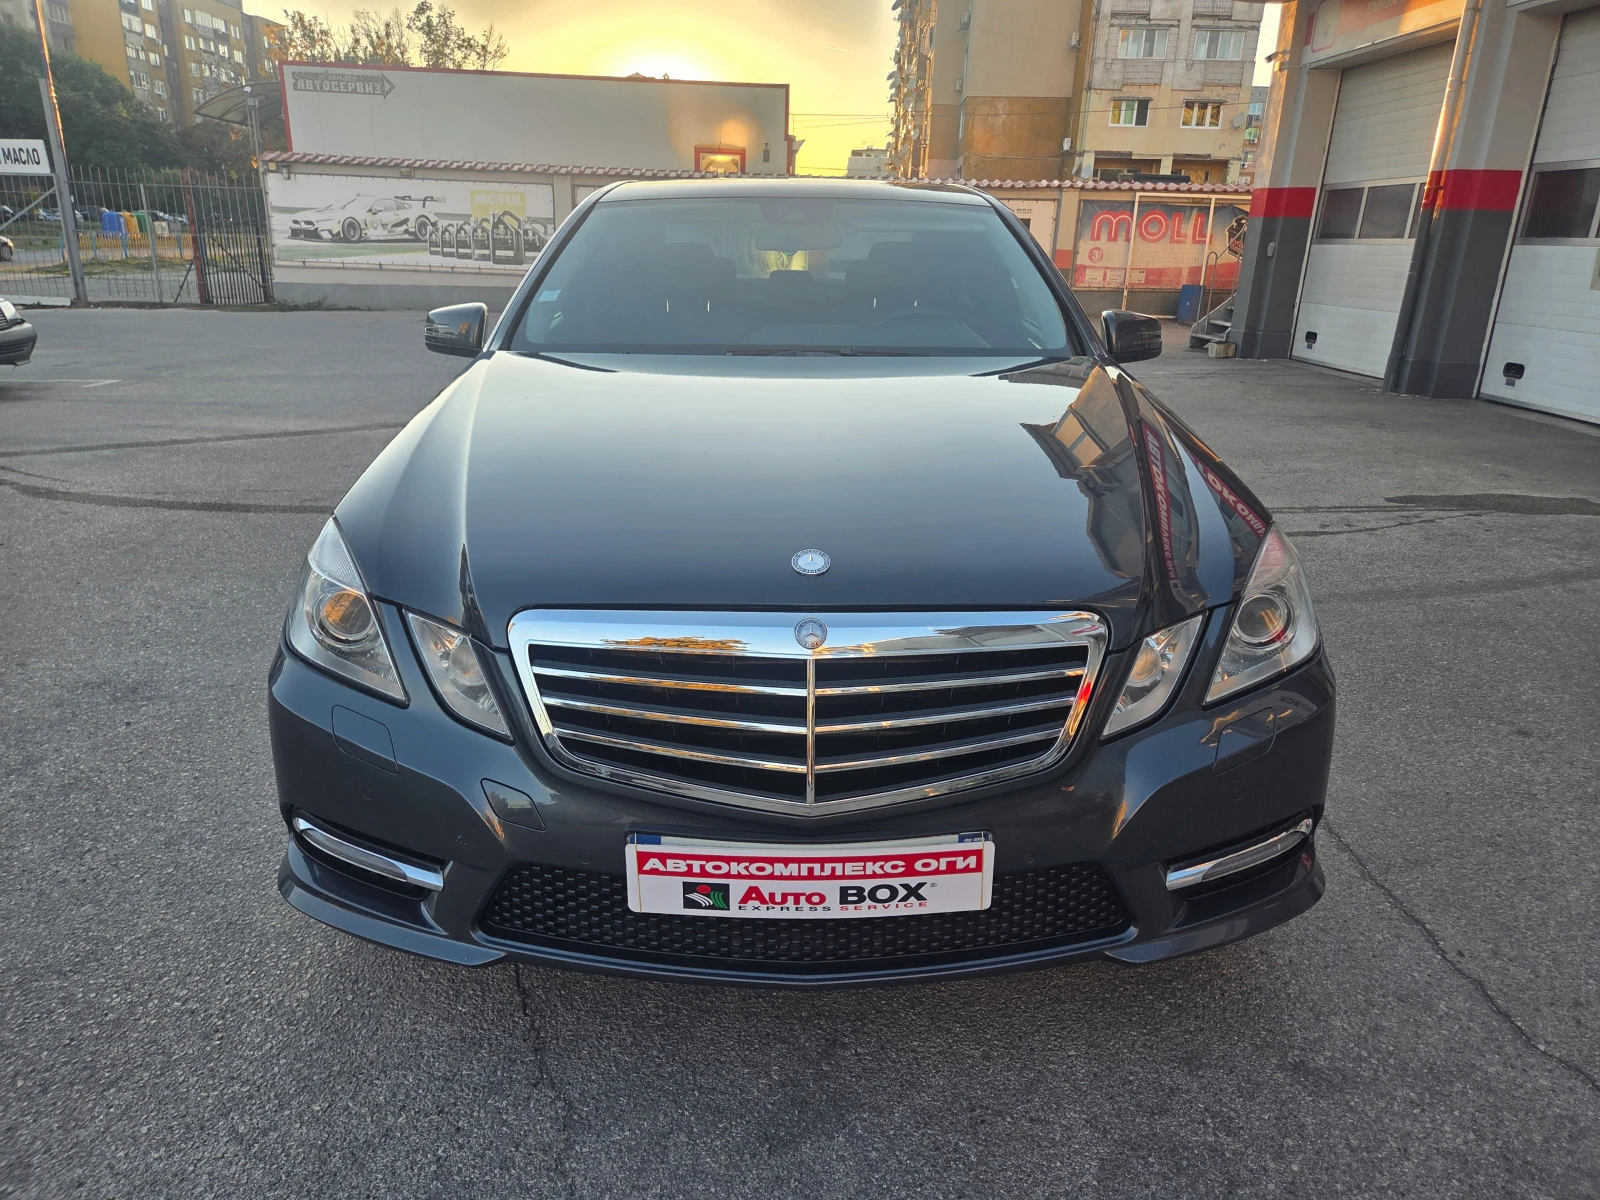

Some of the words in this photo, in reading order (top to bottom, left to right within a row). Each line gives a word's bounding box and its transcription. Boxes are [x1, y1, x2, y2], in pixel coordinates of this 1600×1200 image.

[297, 79, 382, 94] АВТОСЕРВИЗ
[1, 147, 41, 166] МАСЛО
[474, 192, 523, 206] MOTUL
[1090, 209, 1213, 244] MOLL
[642, 858, 906, 876] АВТОКОМПЛЕКС
[914, 855, 977, 872] ОГИ
[839, 902, 928, 911] SERVICE
